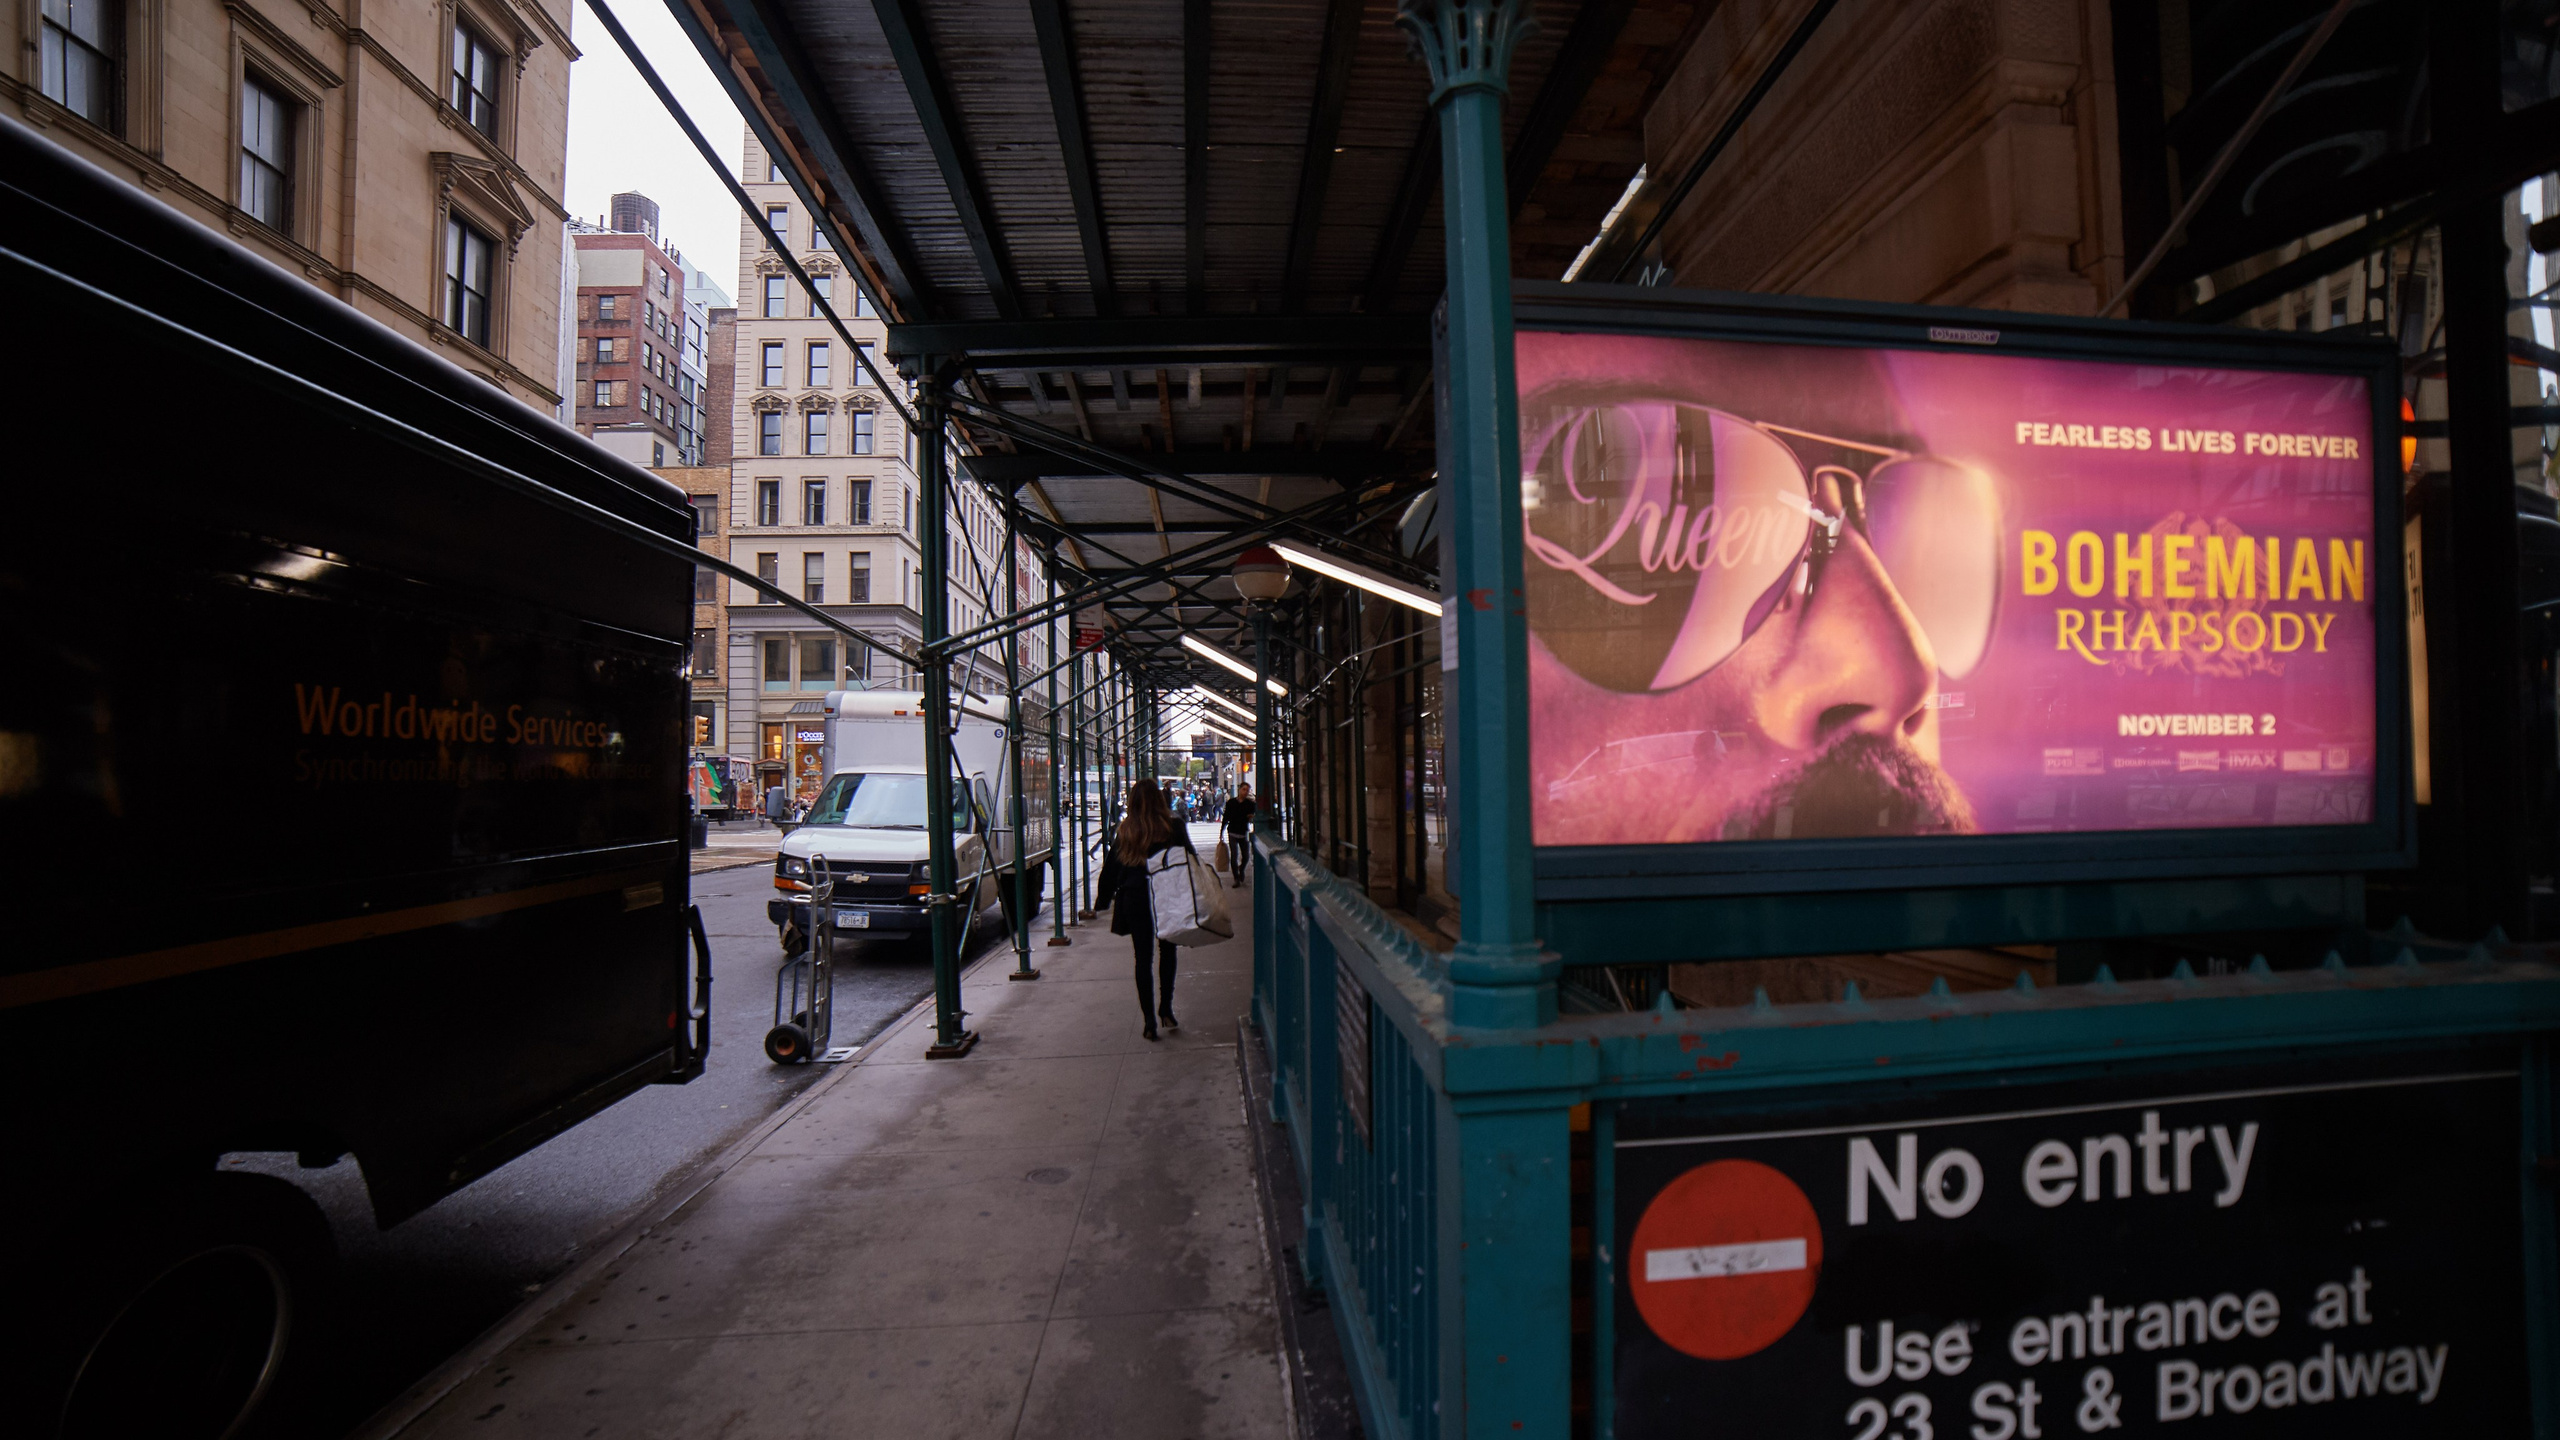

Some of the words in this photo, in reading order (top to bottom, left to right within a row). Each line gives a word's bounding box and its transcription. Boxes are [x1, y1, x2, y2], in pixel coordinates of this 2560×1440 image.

[2017, 422, 2151, 450] FEARLESS
[2160, 429, 2236, 454] LIVES
[2245, 433, 2359, 460] FOREVER
[1522, 403, 1800, 605] Queen
[2022, 530, 2364, 602] BOHEMIAN
[2056, 609, 2336, 665] RHAPSODY
[294, 682, 496, 743] Worldwide
[506, 704, 609, 747] Services
[2118, 714, 2254, 736] NOVEMBER
[2261, 714, 2277, 736] 2
[294, 748, 469, 790] Synchronizing
[2229, 755, 2277, 767] IMAX
[1846, 1132, 1985, 1226] No
[2021, 1110, 2260, 1209] entry
[1844, 1319, 1974, 1387] Use
[2008, 1289, 2281, 1367] entrance
[2311, 1265, 2373, 1330] at
[1844, 1391, 1936, 1440] 23
[1970, 1377, 2043, 1440] St
[2075, 1365, 2124, 1433] &
[2155, 1341, 2448, 1422] Broadway
